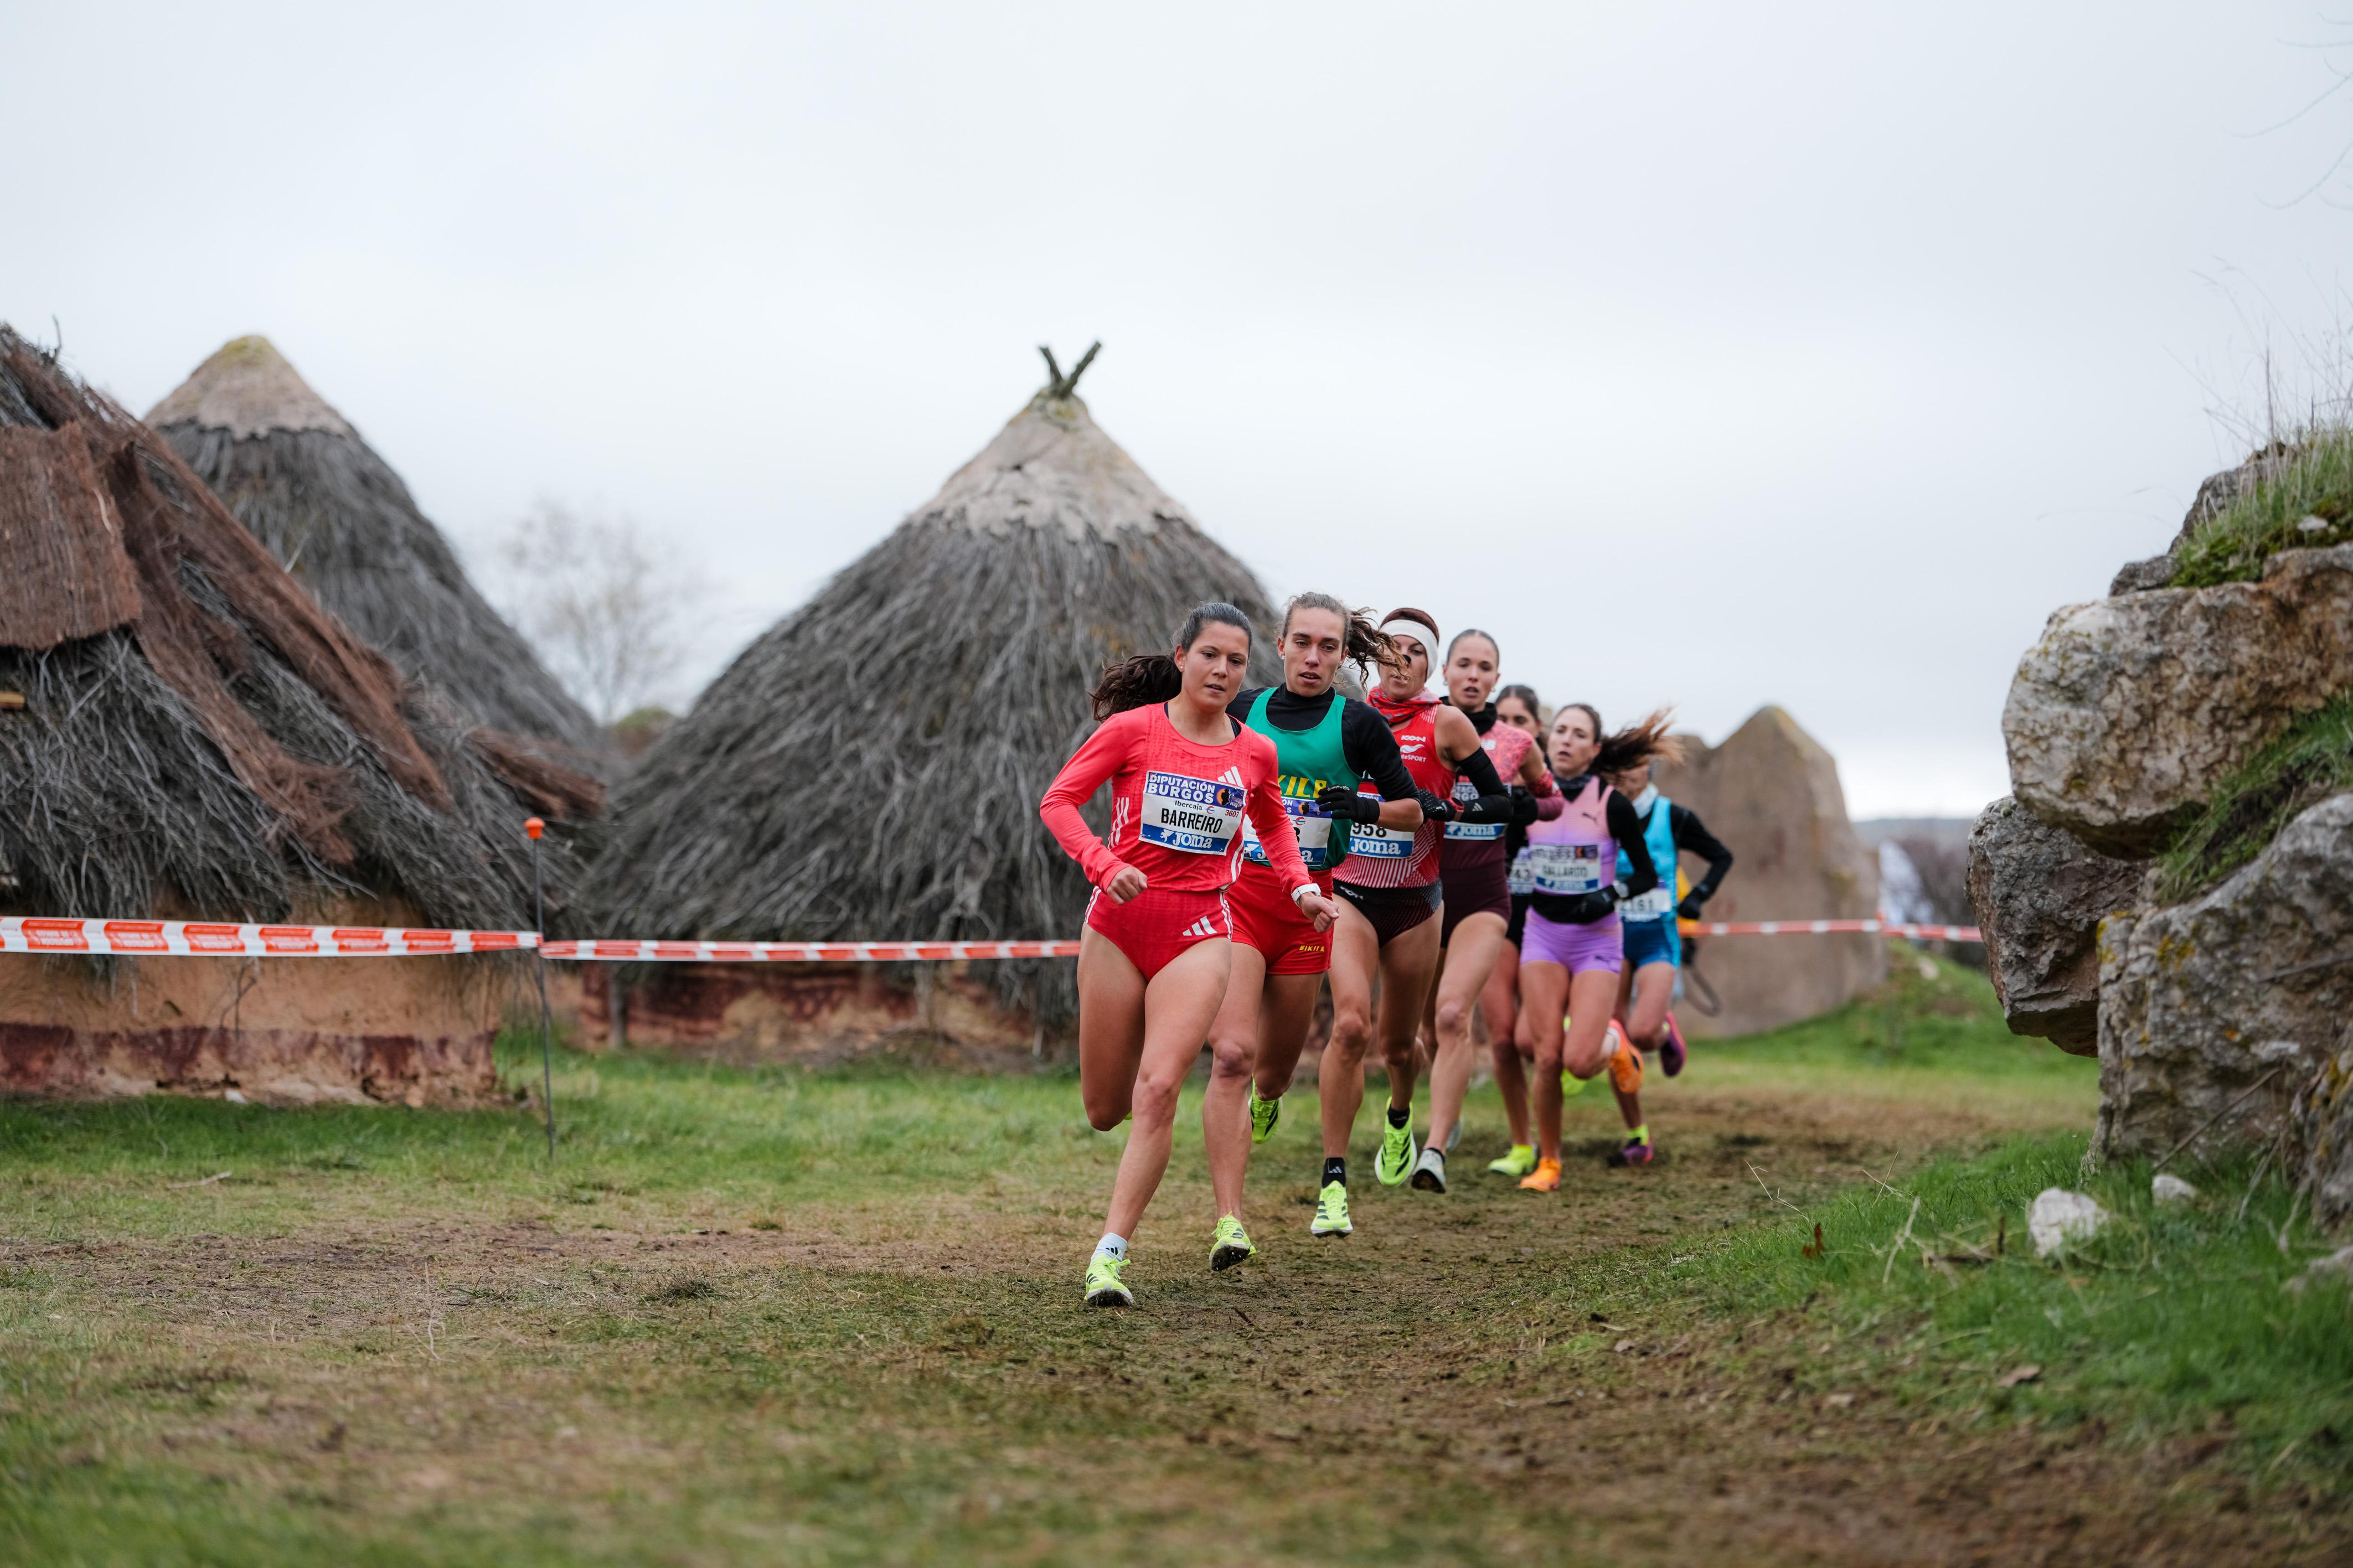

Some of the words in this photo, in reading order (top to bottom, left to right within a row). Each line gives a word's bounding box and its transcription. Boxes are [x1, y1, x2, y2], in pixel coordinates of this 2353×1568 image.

[1149, 775, 1215, 793] DIPUTACIÓN
[1148, 783, 1214, 804] BURGOS
[1175, 800, 1203, 811] Ibercaja
[1225, 810, 1240, 818] 3607
[1161, 808, 1223, 834] BARREIRO
[1172, 830, 1212, 848] Joma
[1351, 838, 1401, 855] Joma
